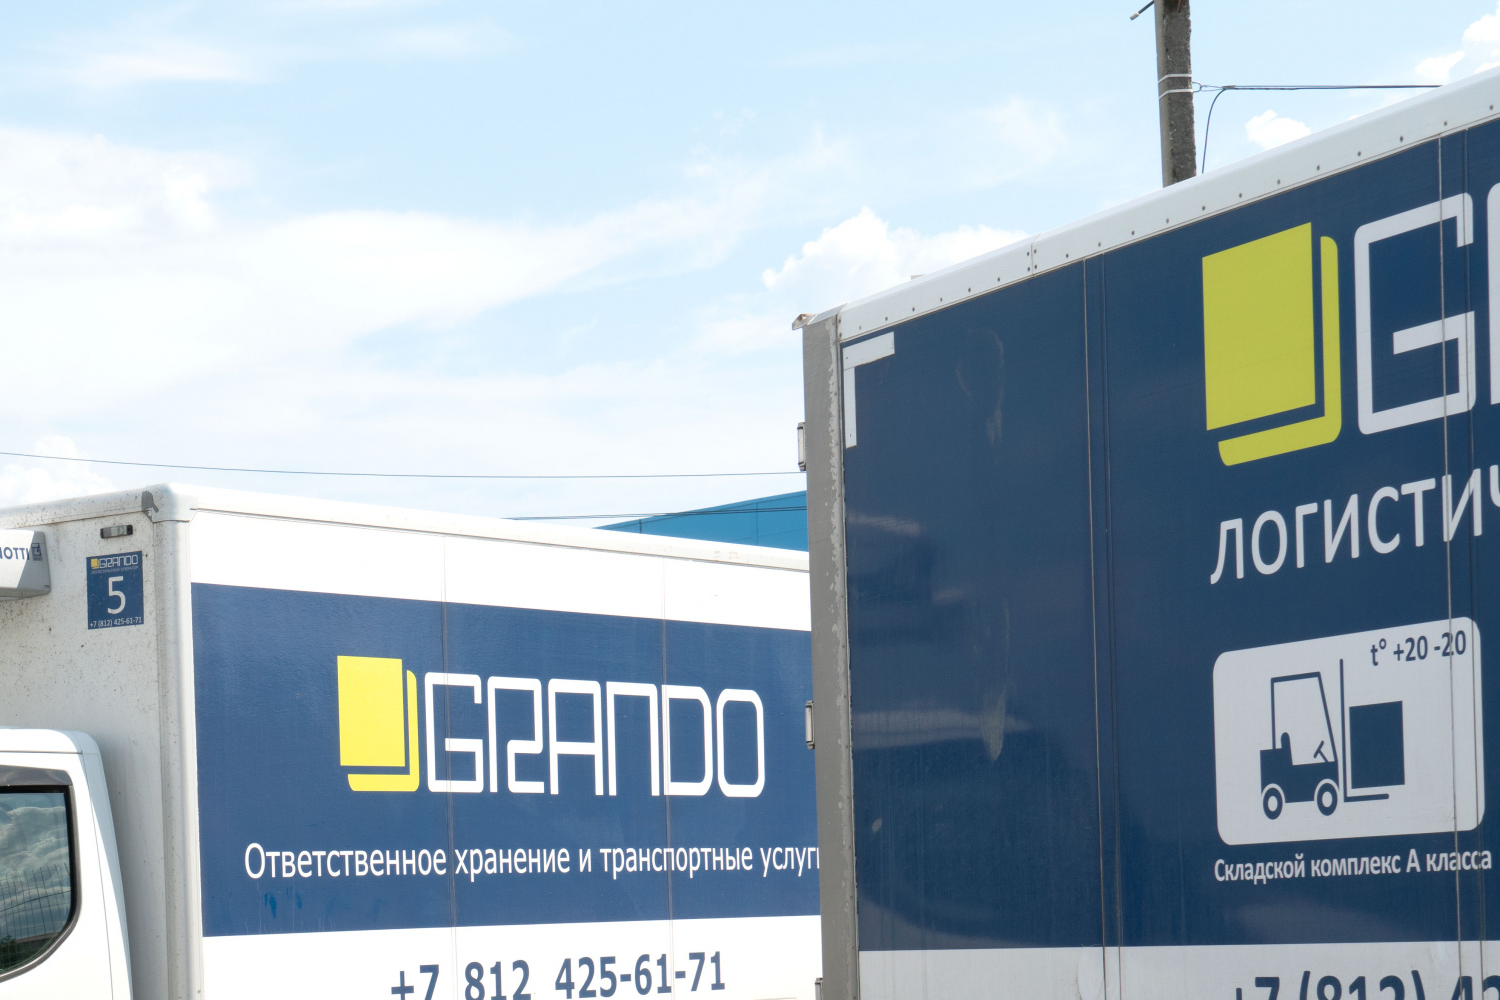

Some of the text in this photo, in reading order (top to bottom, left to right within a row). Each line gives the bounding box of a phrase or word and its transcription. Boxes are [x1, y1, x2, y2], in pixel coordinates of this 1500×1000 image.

[107, 576, 126, 615] 5
[1393, 635, 1429, 662] +20
[1433, 629, 1467, 657] -20
[424, 672, 766, 798] GRANDO
[244, 842, 820, 882] Ответственное хранение и транспортные услуг
[1214, 848, 1493, 885] Складской комплекс А класса
[554, 950, 726, 1000] 425-61-71
